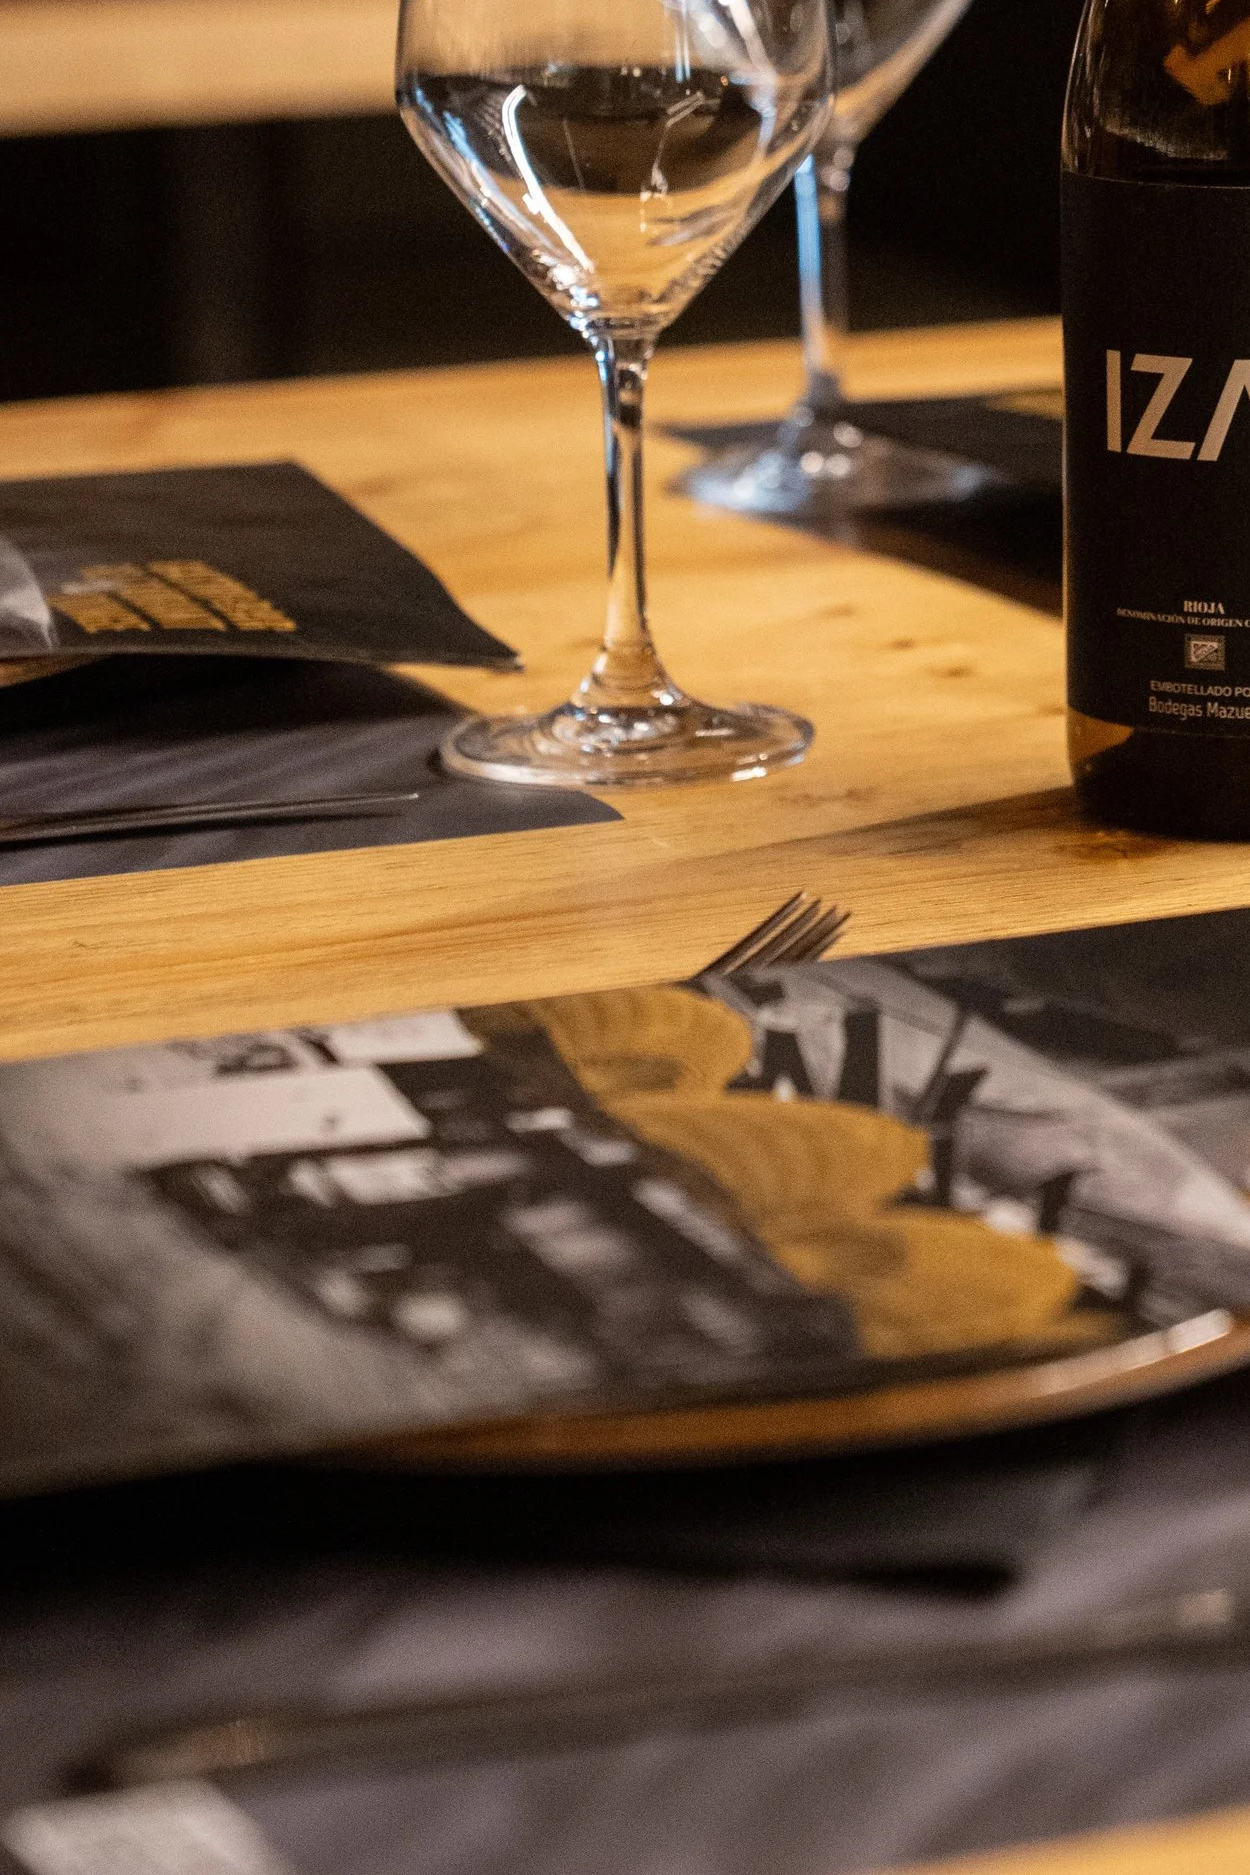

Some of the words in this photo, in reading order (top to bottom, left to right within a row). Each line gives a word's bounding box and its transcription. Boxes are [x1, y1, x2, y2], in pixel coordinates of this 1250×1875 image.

[1183, 600, 1225, 615] RIOJA
[1187, 616, 1201, 626] DE
[1202, 617, 1243, 628] ORIGEN
[1150, 680, 1232, 697] EMBOTELLADO
[1149, 696, 1203, 720] Bodegas
